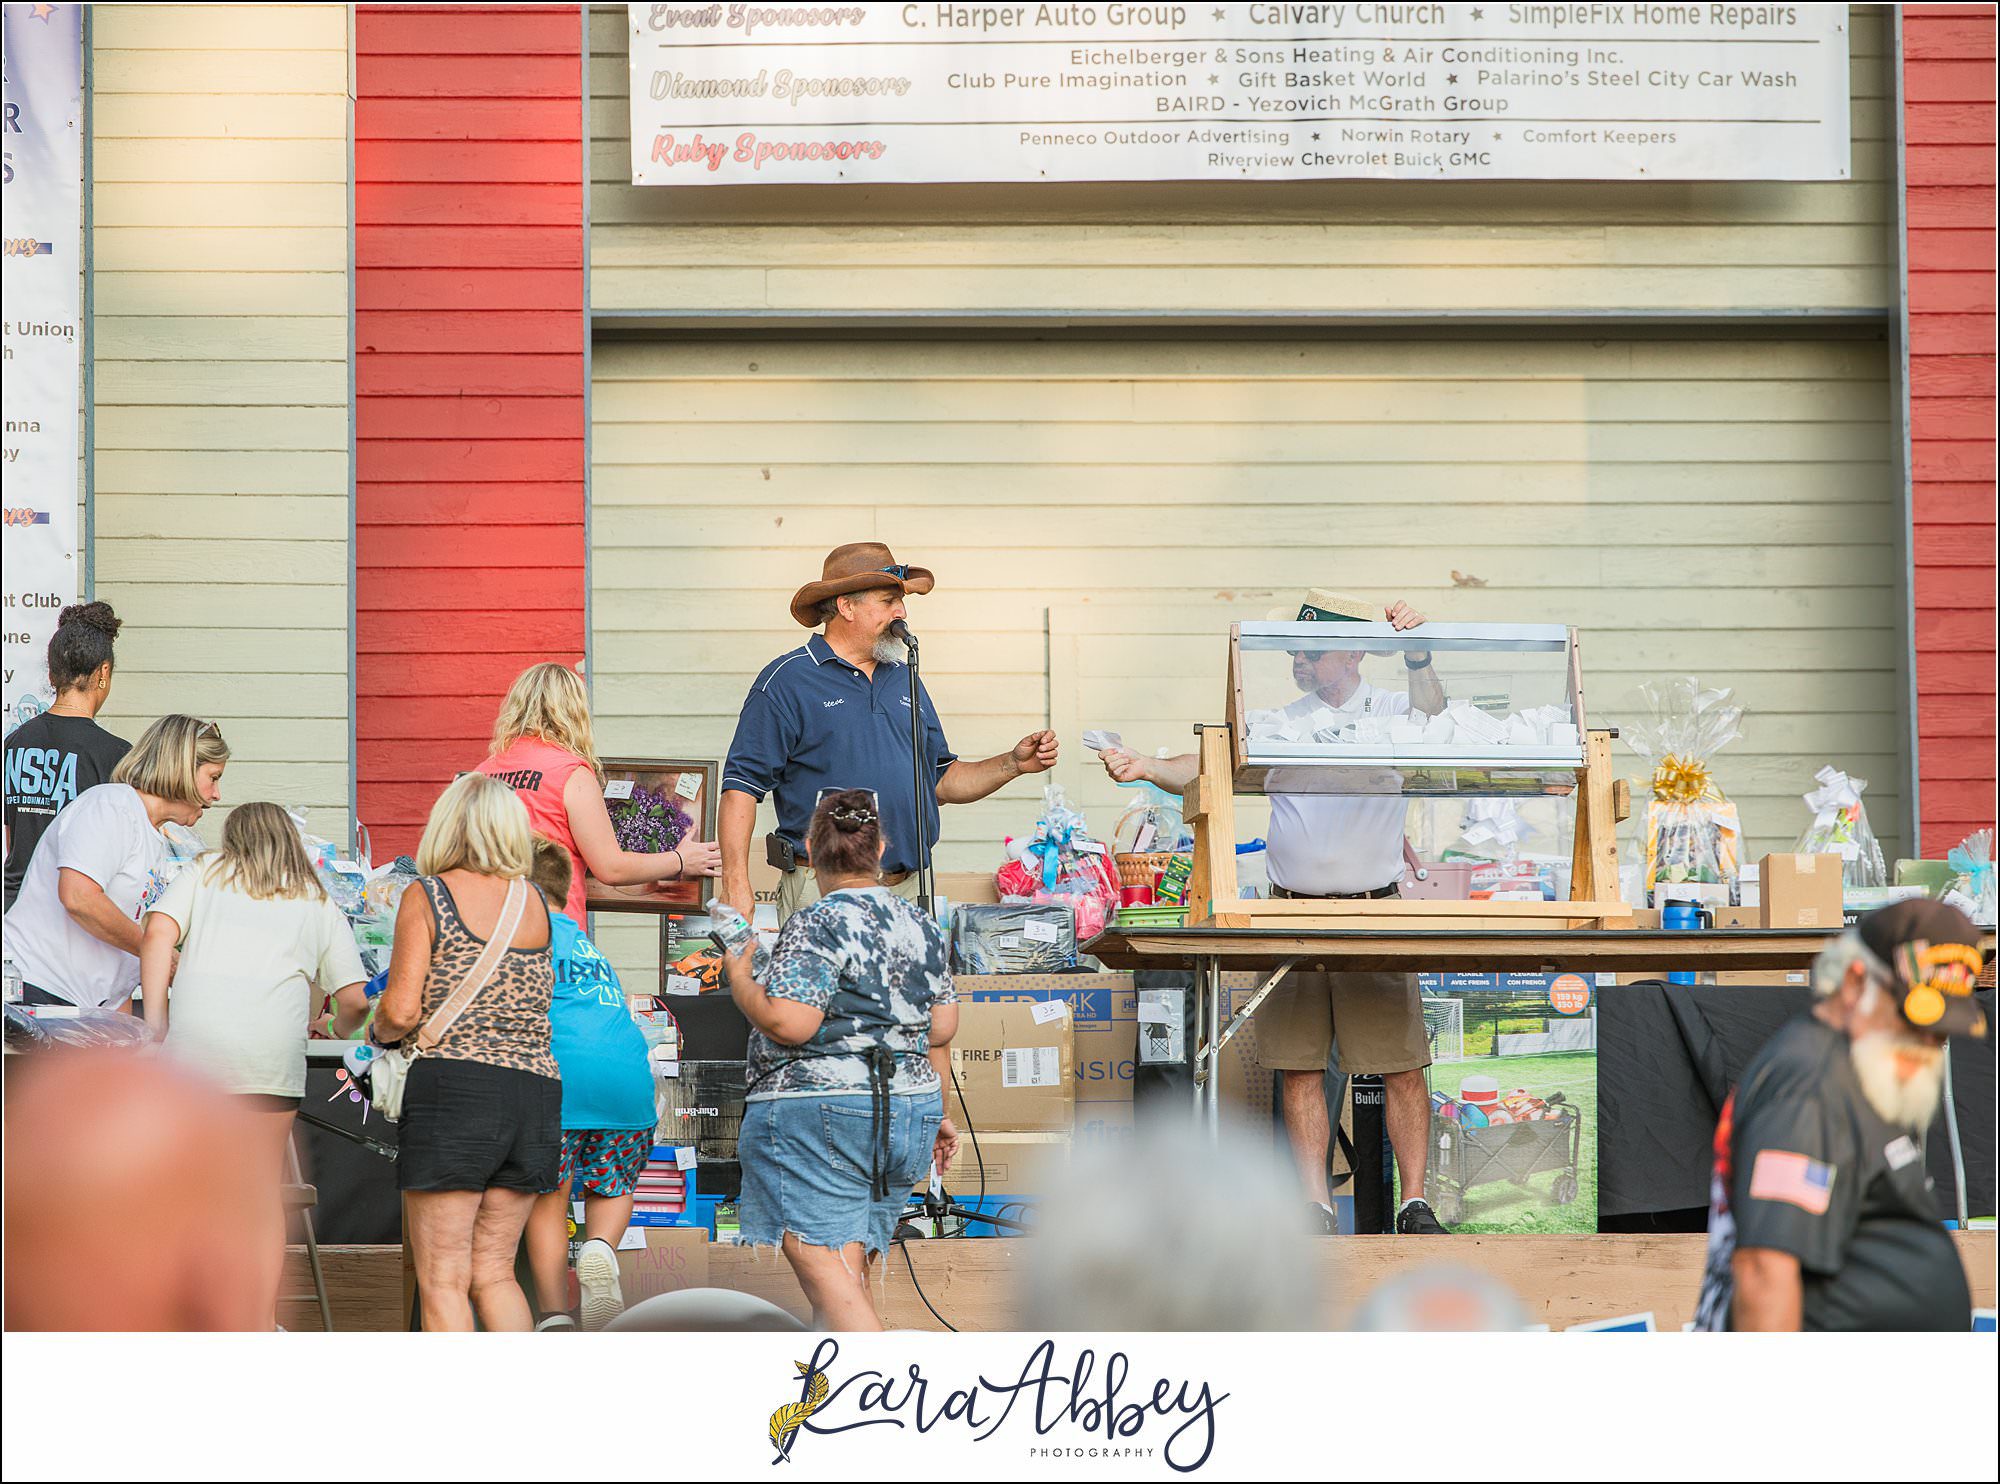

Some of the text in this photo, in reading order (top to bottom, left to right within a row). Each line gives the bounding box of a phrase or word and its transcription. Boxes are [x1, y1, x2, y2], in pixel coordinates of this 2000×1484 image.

[648, 4, 866, 37] Event Sponosors
[902, 4, 1187, 32] C. Harper Auto Group
[1249, 4, 1445, 29] Calvary Church
[1509, 4, 1797, 30] SimpleFix Home Repairs
[1070, 46, 1624, 68] Eichelberger & Sons Heating & Air Conditioning Inc.
[650, 68, 912, 107] Diamond Sponosors
[947, 70, 1187, 91] Club Pure Imagination
[1238, 70, 1426, 89] Gift Basket World
[1588, 70, 1640, 87] Steel
[1647, 70, 1690, 90] City
[1697, 71, 1734, 87] Car
[1741, 70, 1797, 88] Wash
[1156, 96, 1226, 113] BAIRD
[1247, 94, 1341, 113] Yezovich
[1349, 94, 1436, 112] McGrath
[1443, 95, 1509, 115] Group
[1019, 128, 1290, 147] Penneco Outdoor Advertising
[1341, 128, 1471, 146] Norwin Rotary
[1523, 128, 1677, 146] Comfort Keepers
[651, 132, 887, 171] Ruby Sponosors
[1207, 151, 1491, 169] Riverview Chevrolet Buick GMC
[17, 321, 74, 337] Union
[21, 593, 62, 608] Club
[962, 1049, 991, 1061] FIRE
[636, 1245, 687, 1271] PARIS
